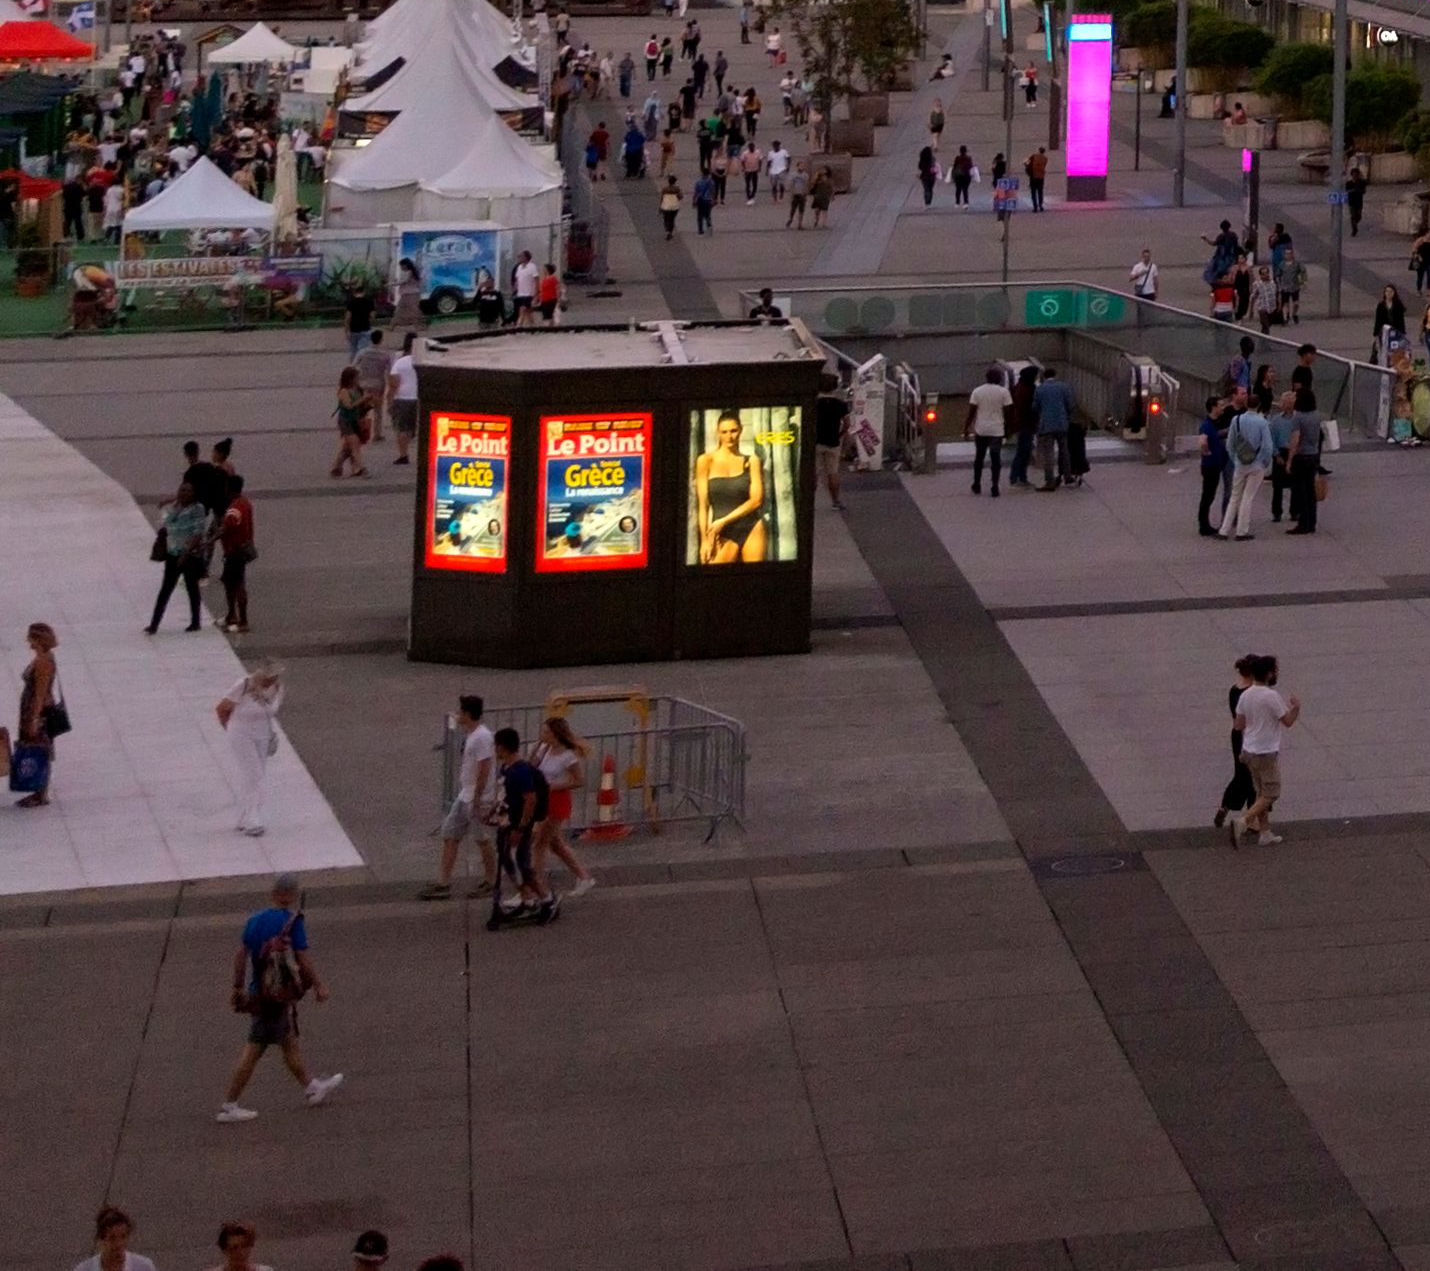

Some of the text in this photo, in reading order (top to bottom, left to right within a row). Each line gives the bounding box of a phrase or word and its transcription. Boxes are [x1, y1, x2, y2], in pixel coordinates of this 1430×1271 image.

[436, 433, 508, 456] Le Point
[546, 431, 645, 456] Le Point
[448, 462, 494, 488] Grèce
[564, 462, 626, 488] Grèce
